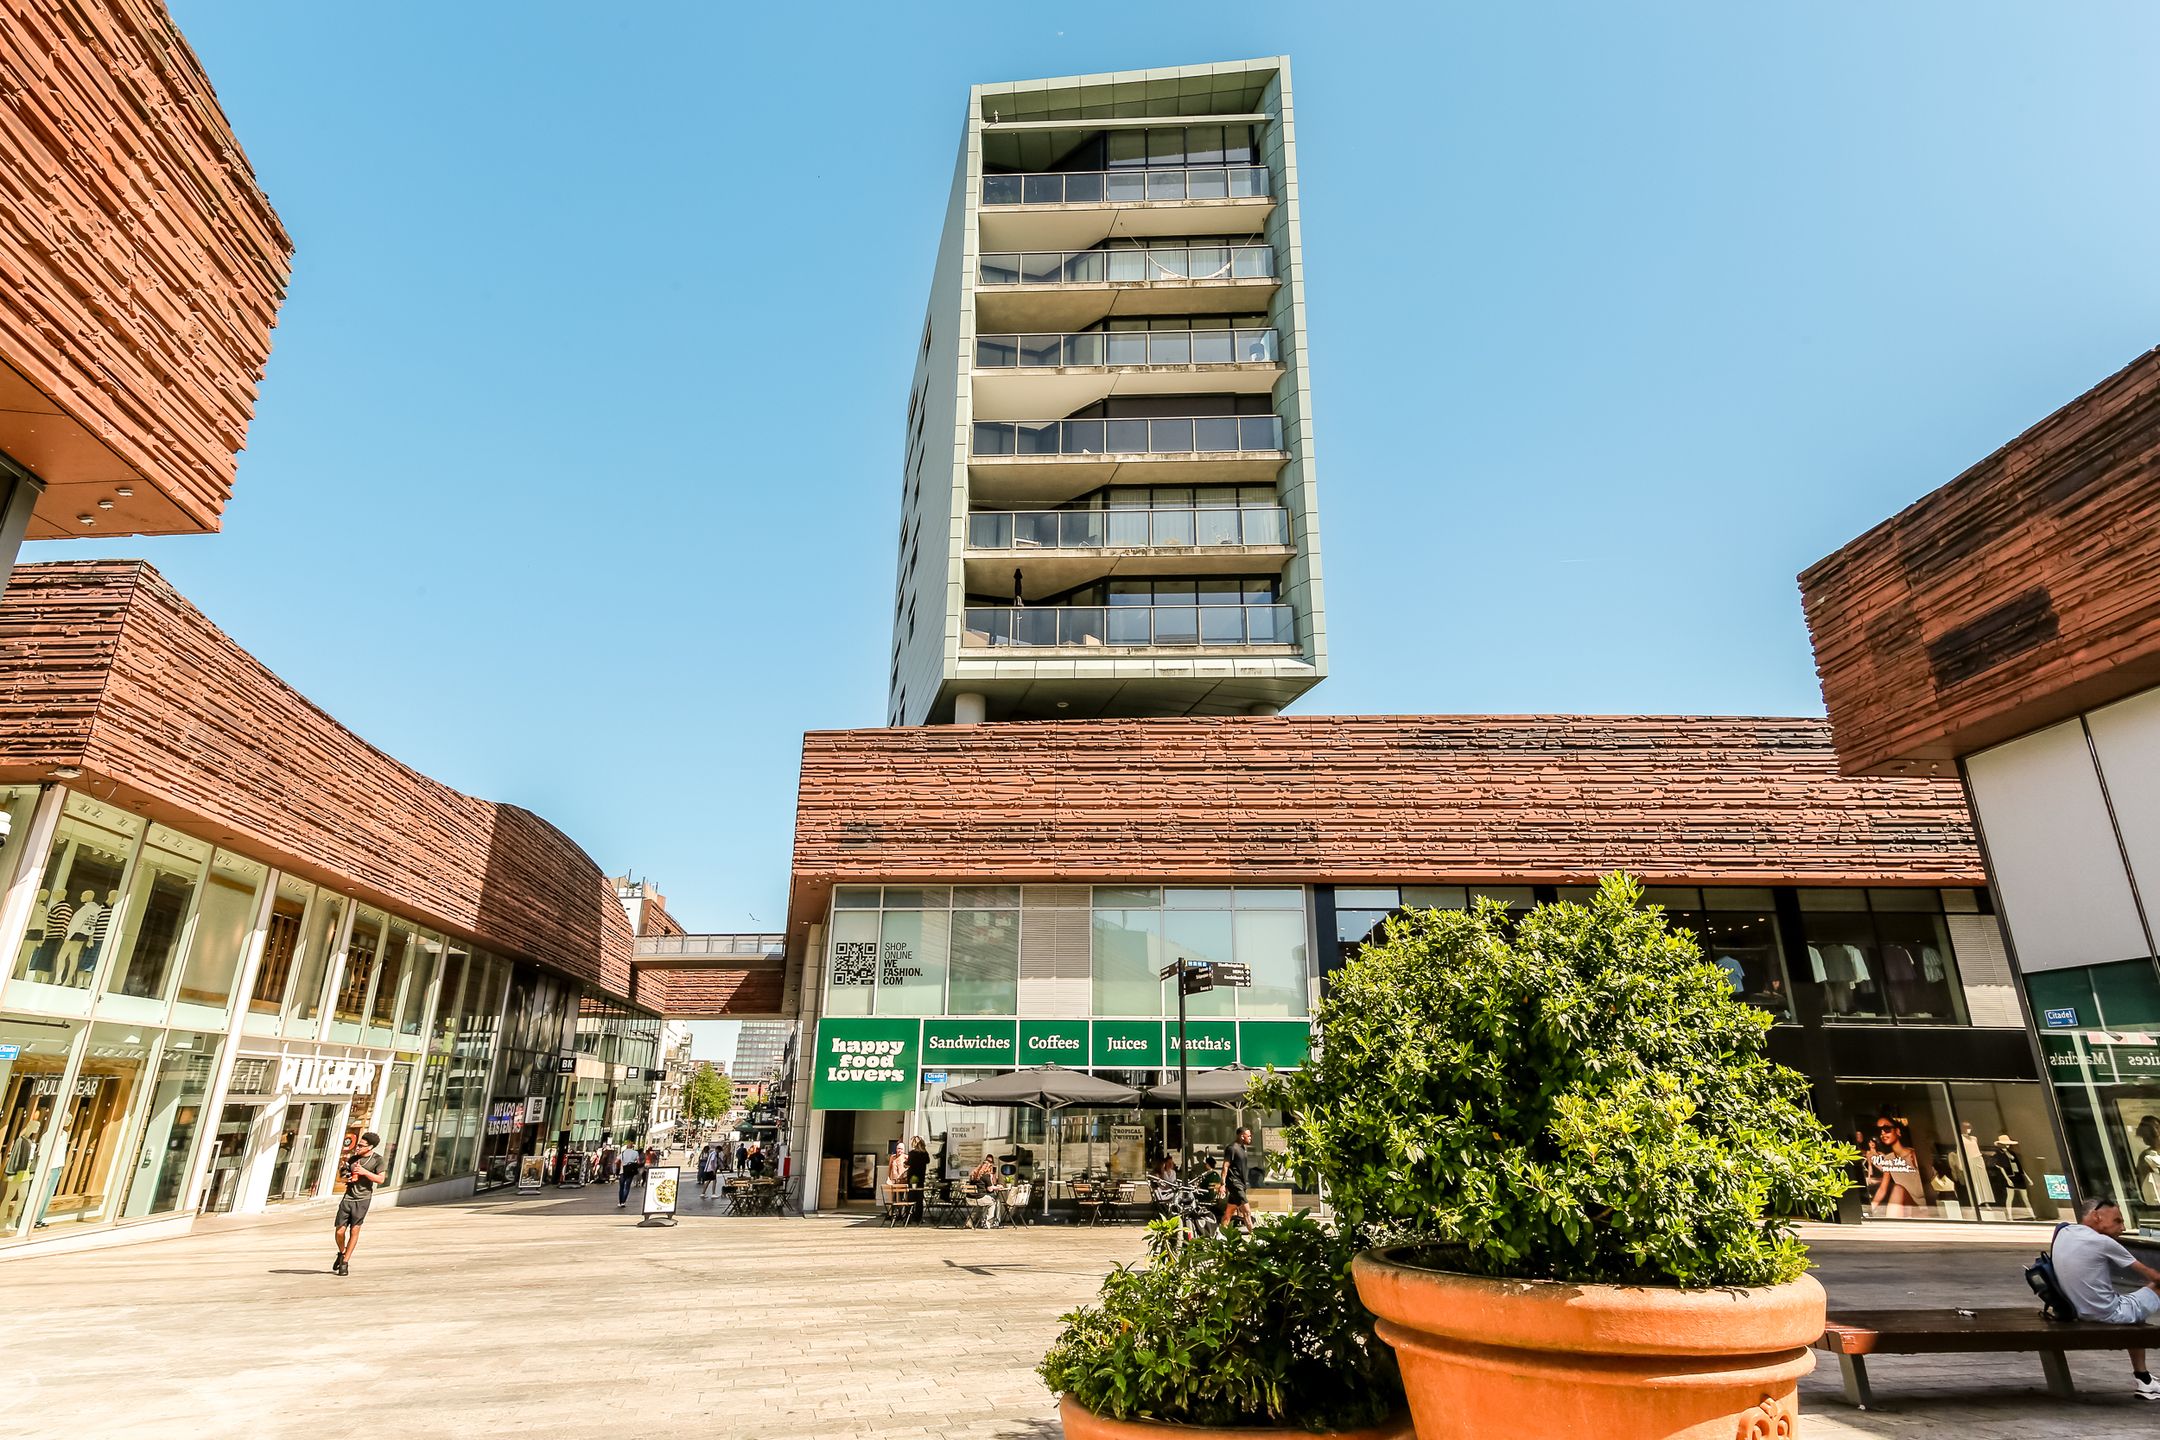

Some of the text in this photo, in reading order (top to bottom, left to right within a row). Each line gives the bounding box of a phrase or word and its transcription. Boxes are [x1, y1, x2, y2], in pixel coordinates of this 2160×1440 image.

[885, 942, 907, 951] SHOP
[884, 951, 913, 960] ONLINE
[884, 960, 898, 968] WE
[883, 968, 923, 977] FASHION.
[882, 977, 903, 986] COM
[2047, 1010, 2073, 1020] Citadel
[831, 1037, 905, 1055] happy
[929, 1034, 1010, 1049] Sandwiches
[1028, 1034, 1080, 1050] Coffees
[1107, 1036, 1148, 1052] Juices
[1170, 1036, 1231, 1051] Matcha's
[562, 1059, 573, 1068] BK
[840, 1054, 894, 1068] food
[275, 1058, 376, 1095] PULL&BEAR
[827, 1067, 904, 1082] lovers
[1872, 1154, 1906, 1165] Wear the
